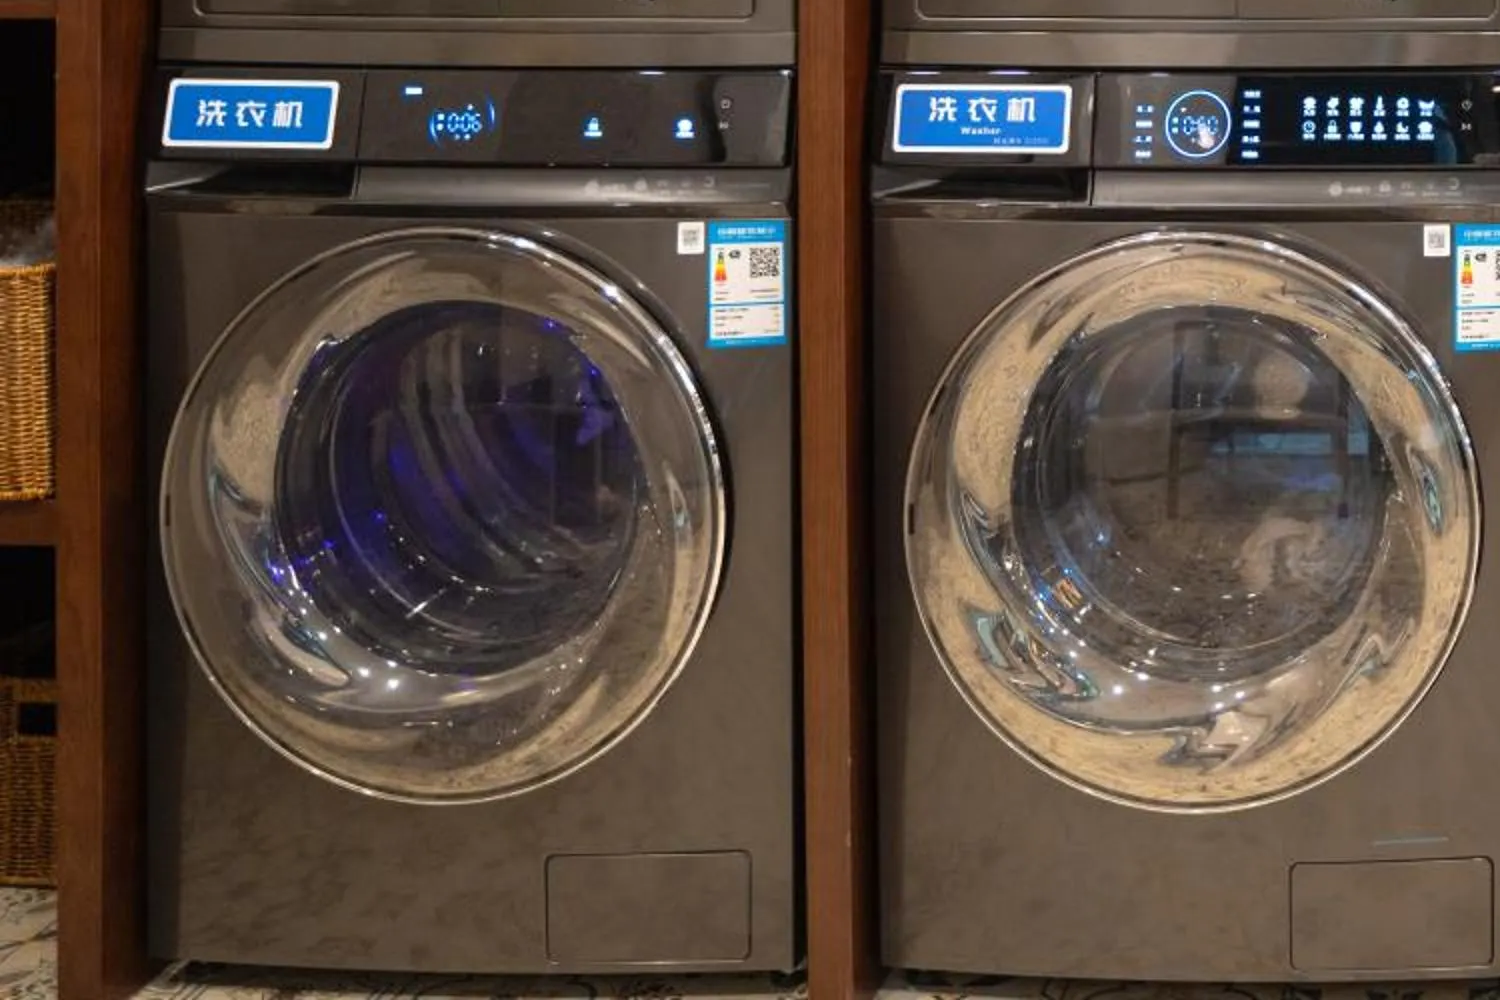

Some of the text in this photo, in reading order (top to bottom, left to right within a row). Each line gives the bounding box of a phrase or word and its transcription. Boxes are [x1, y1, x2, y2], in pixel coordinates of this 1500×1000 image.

[196, 99, 303, 128] 洗衣机
[929, 96, 1036, 123] 洗衣机
